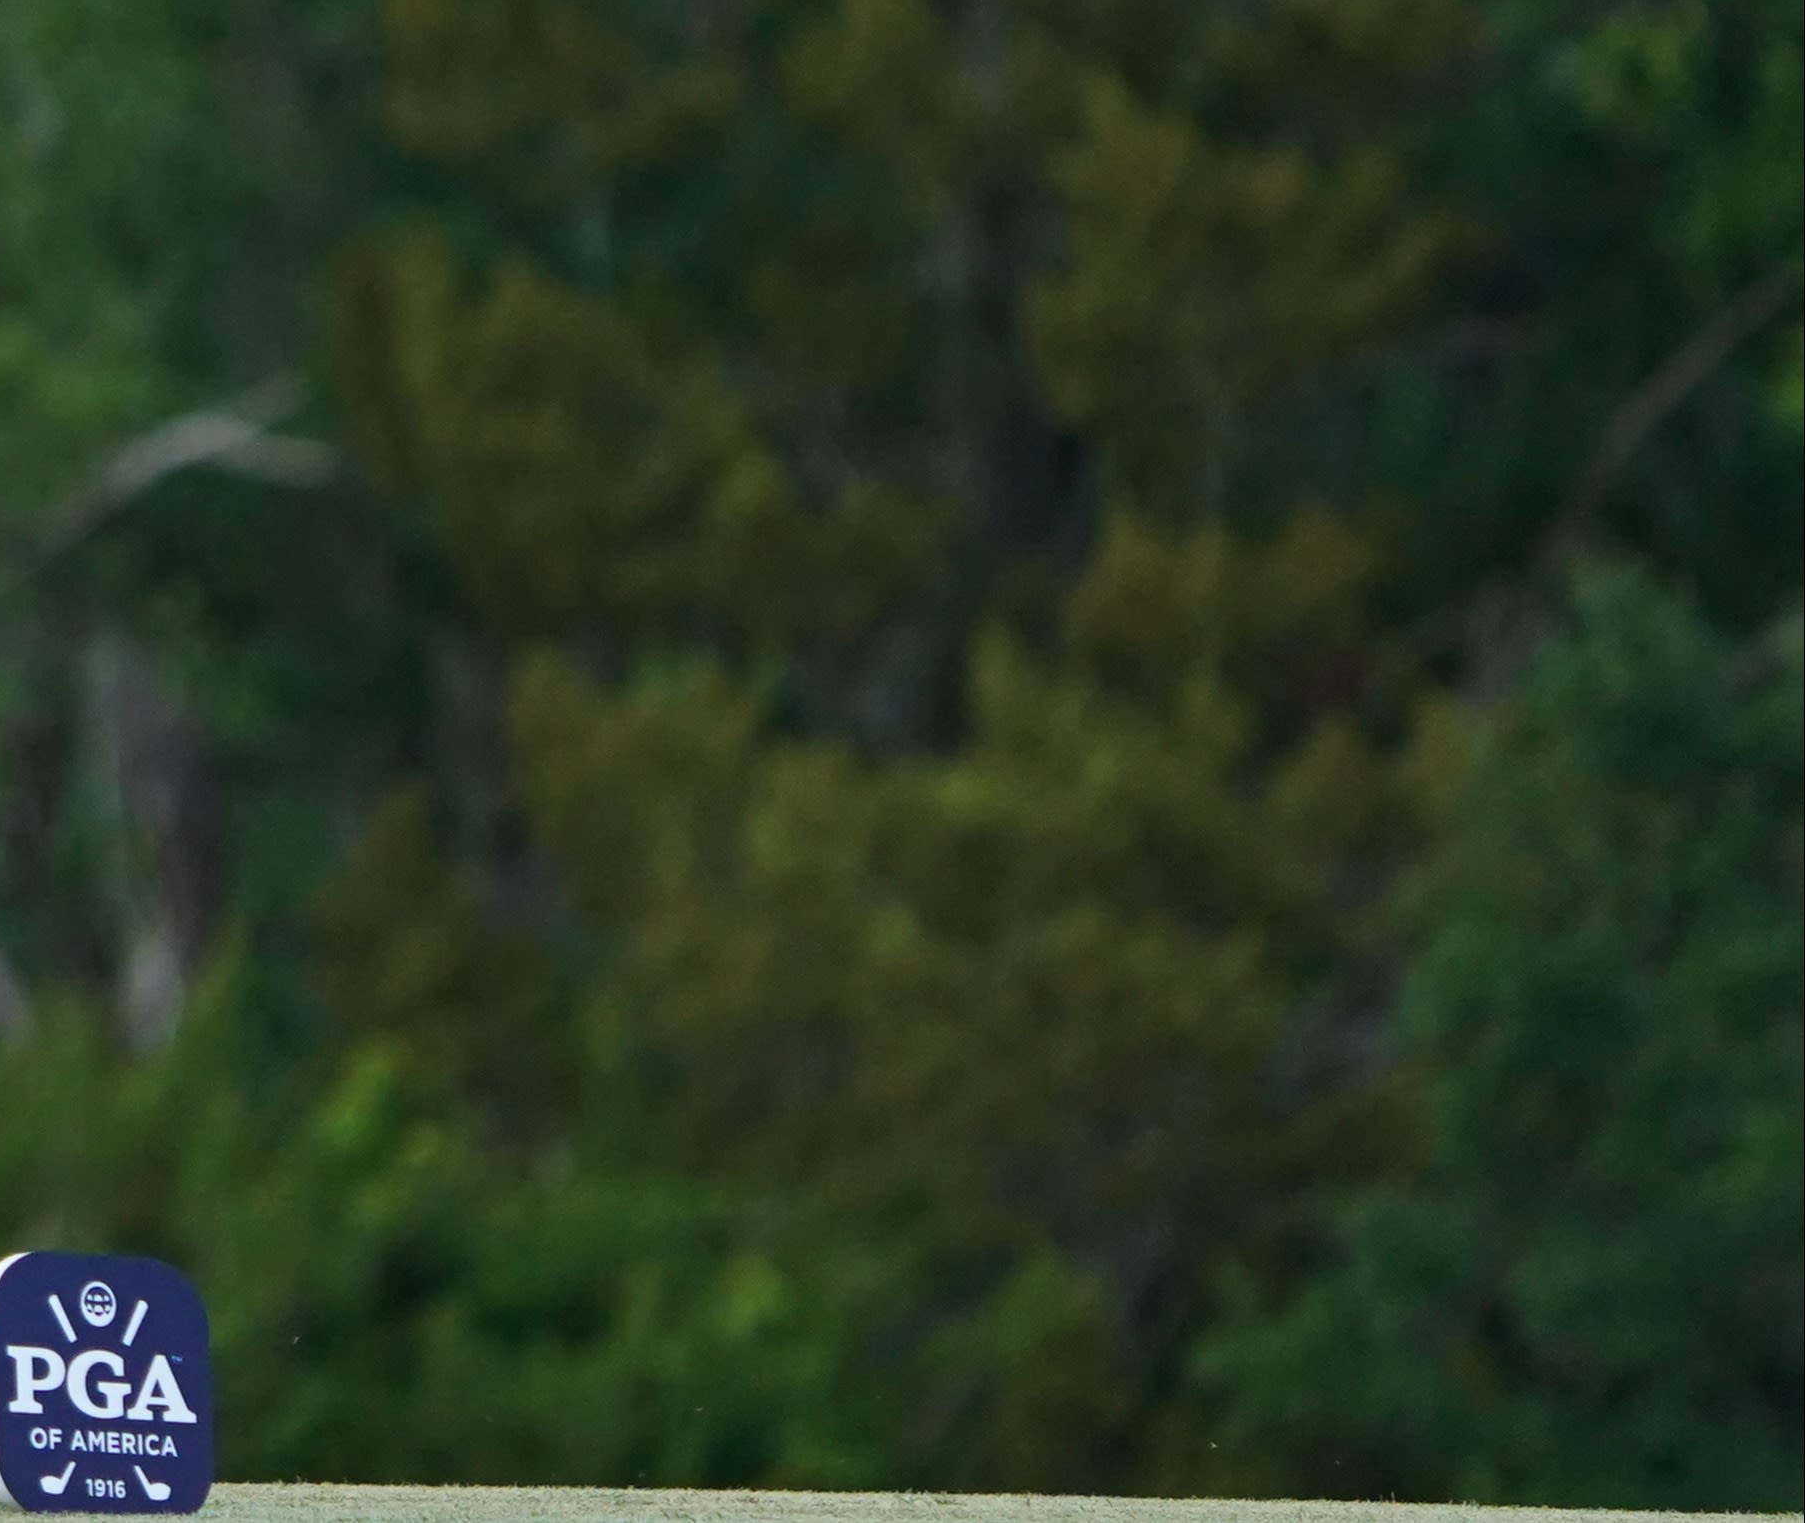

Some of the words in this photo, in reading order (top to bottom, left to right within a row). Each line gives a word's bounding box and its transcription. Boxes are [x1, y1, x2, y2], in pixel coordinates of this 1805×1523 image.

[6, 1345, 197, 1423] PGA
[30, 1427, 63, 1450] OF
[70, 1429, 178, 1458] AMERICA
[85, 1478, 127, 1499] 1916
